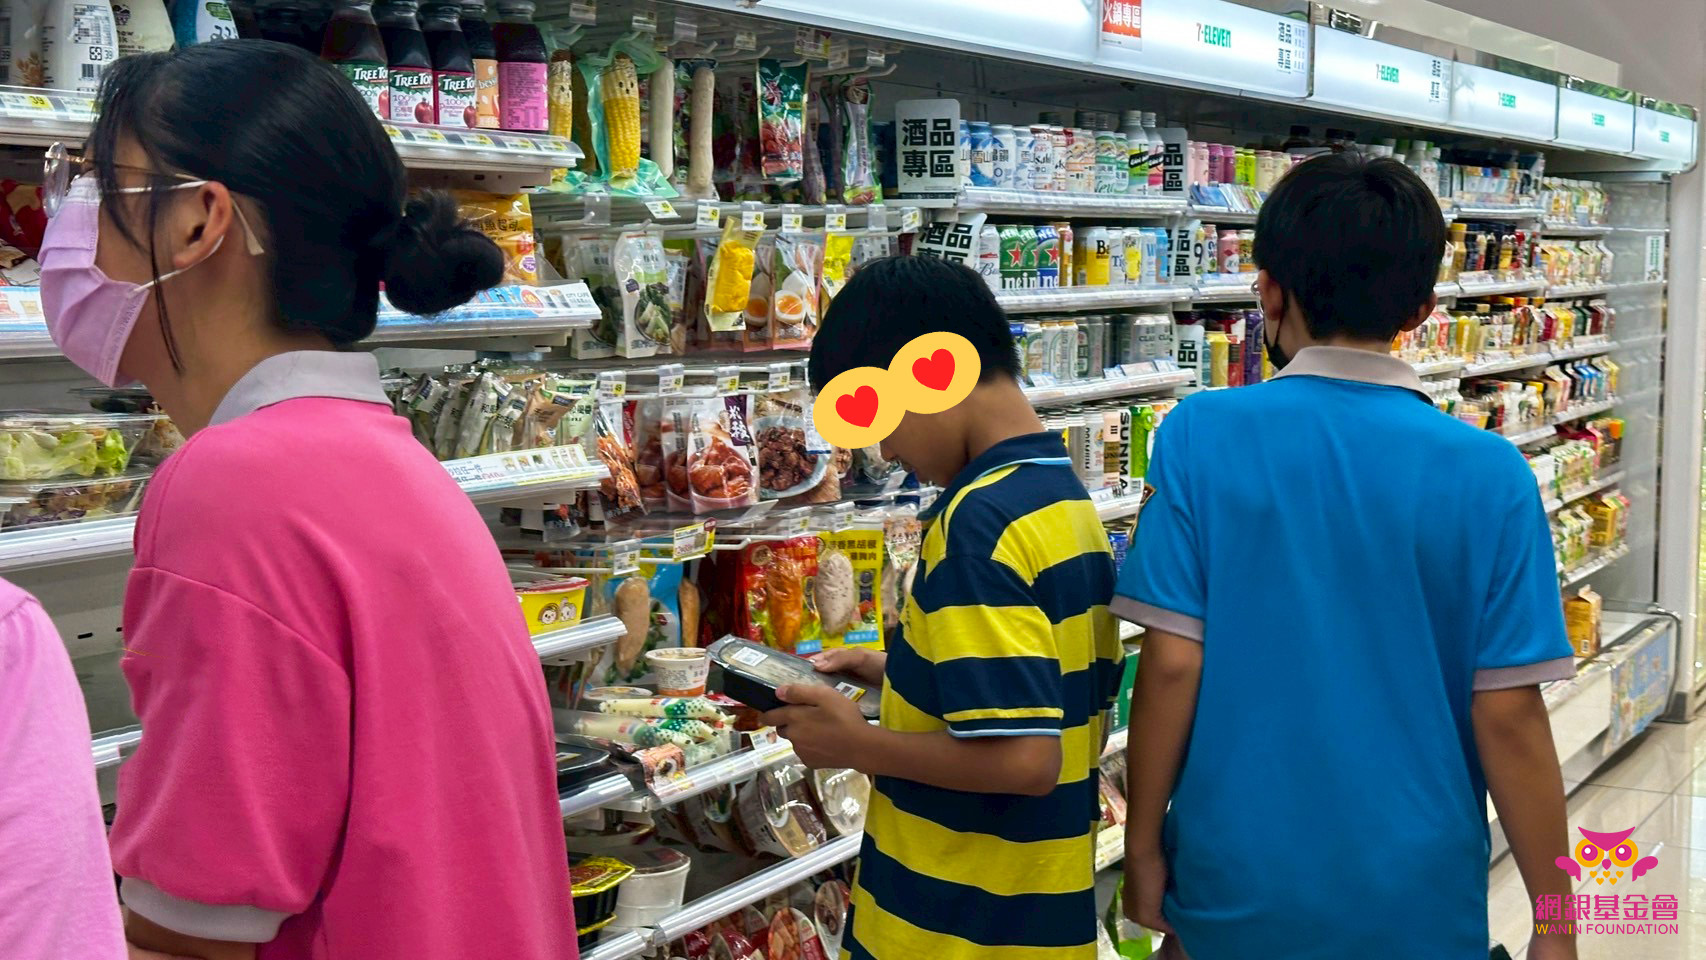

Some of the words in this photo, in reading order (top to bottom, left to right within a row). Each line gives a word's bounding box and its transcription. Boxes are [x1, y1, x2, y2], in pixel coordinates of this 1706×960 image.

[1103, 0, 1141, 29] 火鍋專區
[902, 118, 955, 146] 酒品
[902, 149, 955, 178] 專區
[919, 221, 973, 249] 酒品
